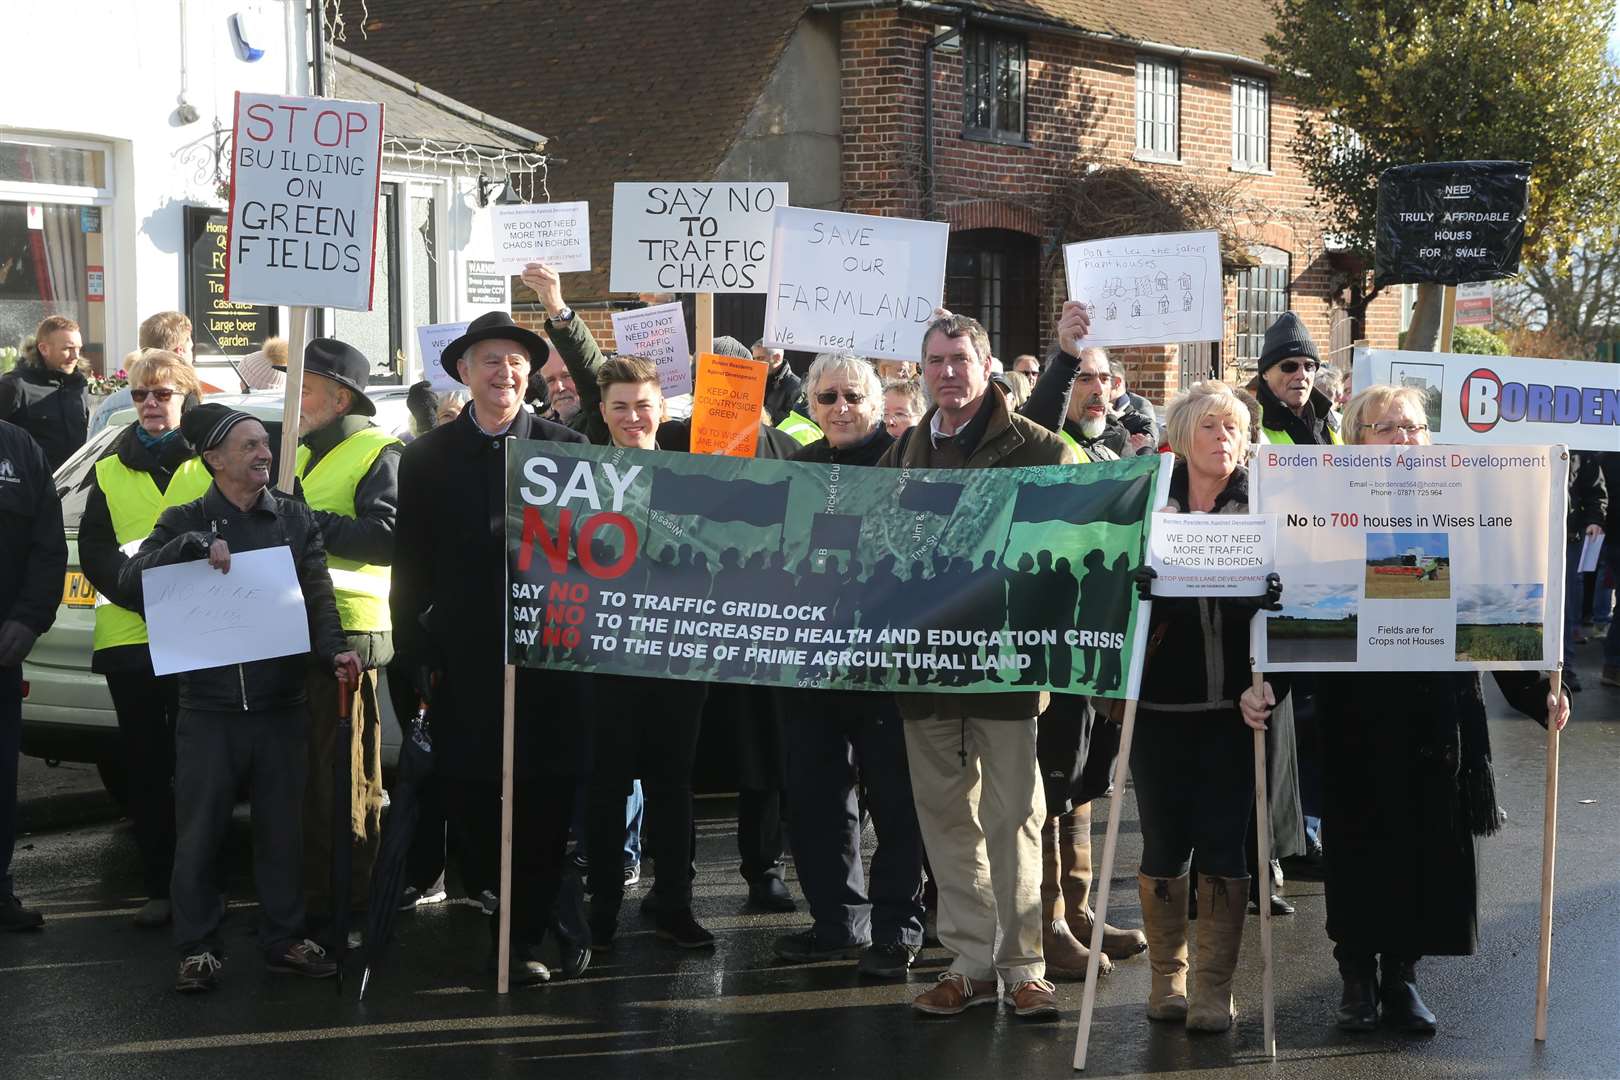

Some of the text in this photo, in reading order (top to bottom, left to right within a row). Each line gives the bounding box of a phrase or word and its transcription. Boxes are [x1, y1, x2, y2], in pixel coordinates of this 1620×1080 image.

[247, 103, 368, 148] STOP
[239, 147, 365, 176] BUILDING
[286, 177, 322, 199] ON
[1445, 184, 1472, 195] NEED
[645, 187, 775, 215] SAY NO
[241, 201, 355, 238] GREEN
[503, 219, 577, 230] WE DO NOT NEED
[1399, 212, 1510, 222] TRULY AFFORDABLE
[679, 216, 718, 237] TO
[510, 229, 572, 240] MORE TRAFFIC
[807, 222, 874, 247] SAVE
[1434, 231, 1472, 241] HOUSES
[502, 238, 580, 249] CHAOS IN BORDEN
[638, 239, 766, 262] TRAFFIC
[238, 235, 361, 273] FIELDS
[1419, 248, 1487, 258] FOR SWALE
[842, 256, 887, 276] OUR
[657, 263, 757, 289] CHAOS
[776, 283, 932, 324] FARMLAND
[210, 318, 257, 333] Large beer
[624, 316, 673, 332] WE DO NOT
[218, 334, 249, 349] garden
[625, 327, 677, 342] NEED MORE
[774, 327, 896, 351] We need it!
[431, 339, 446, 347] WE
[635, 337, 670, 349] TRAFFIC
[665, 346, 674, 354] IN
[656, 356, 673, 366] DEN
[707, 387, 749, 400] KEEP OUR
[698, 395, 757, 412] COUNTRYSIDE
[708, 407, 737, 419] GREEN
[1267, 453, 1546, 471] Borden Residents Against Development
[519, 456, 644, 512] SAY
[825, 463, 841, 515] ricket Clu
[1287, 513, 1513, 528] No to 700 houses in Wises Lane
[517, 506, 640, 580] NO
[1166, 534, 1261, 543] WE DO NOT NEED
[1173, 546, 1254, 555] MORE TRAFFIC
[1162, 556, 1263, 566] CHAOS IN BORDEN
[512, 581, 828, 622] SAY NO TO TRAFFIC GRIDLOCK
[513, 604, 1124, 649] SAY NO TO THE INCREASED HEALTH AND EDUCATION CRISIS
[1378, 626, 1404, 635] Fields
[1422, 626, 1434, 635] for
[514, 627, 1031, 670] SAY NO TO THE USE OF PRIME AGRCULTURAL LAND
[1368, 637, 1445, 647] Crops not Houses
